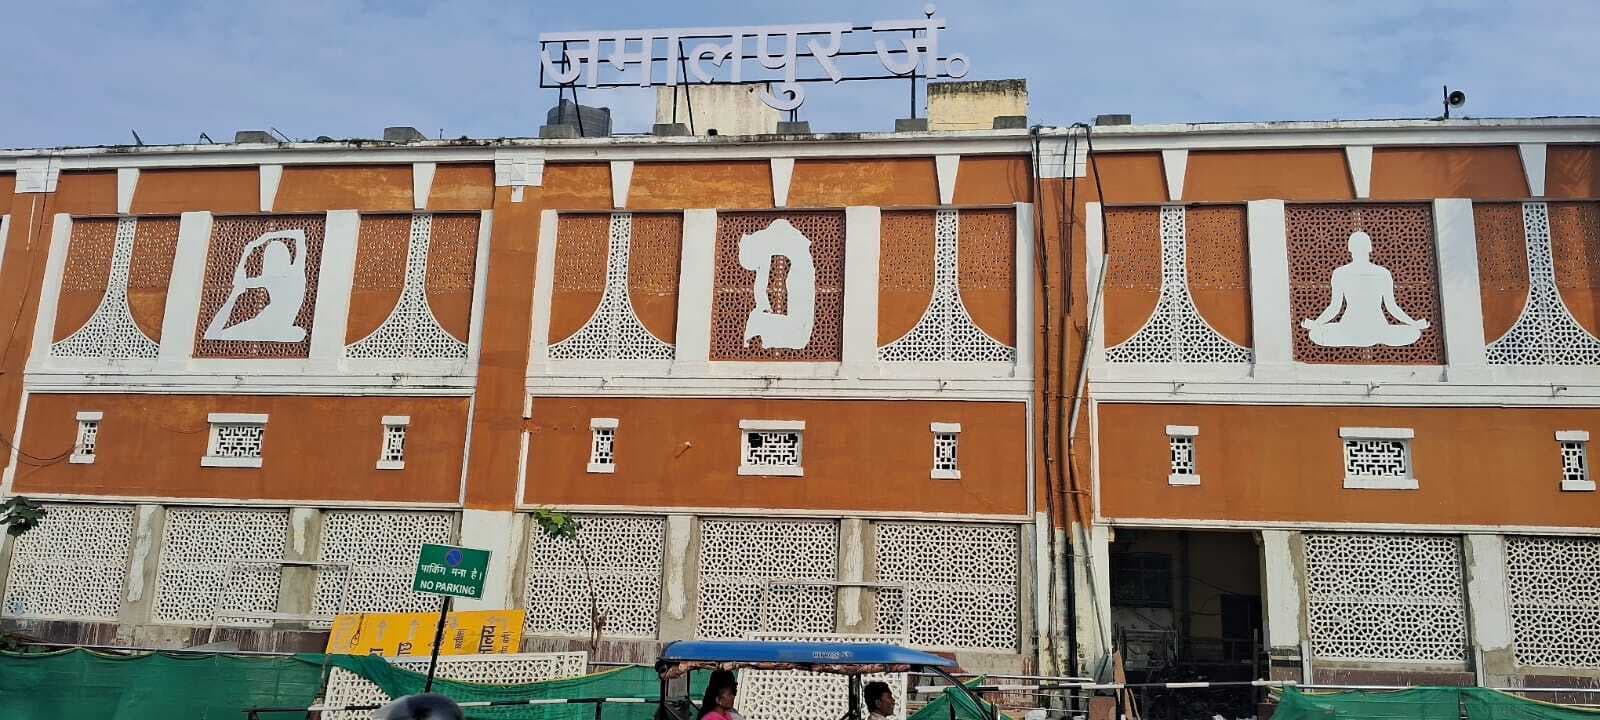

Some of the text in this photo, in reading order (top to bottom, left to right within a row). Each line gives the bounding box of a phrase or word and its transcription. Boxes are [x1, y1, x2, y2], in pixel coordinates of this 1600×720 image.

[539, 22, 852, 111] जमालपुर
[452, 567, 467, 577] मना
[420, 580, 476, 595] NO PARKING
